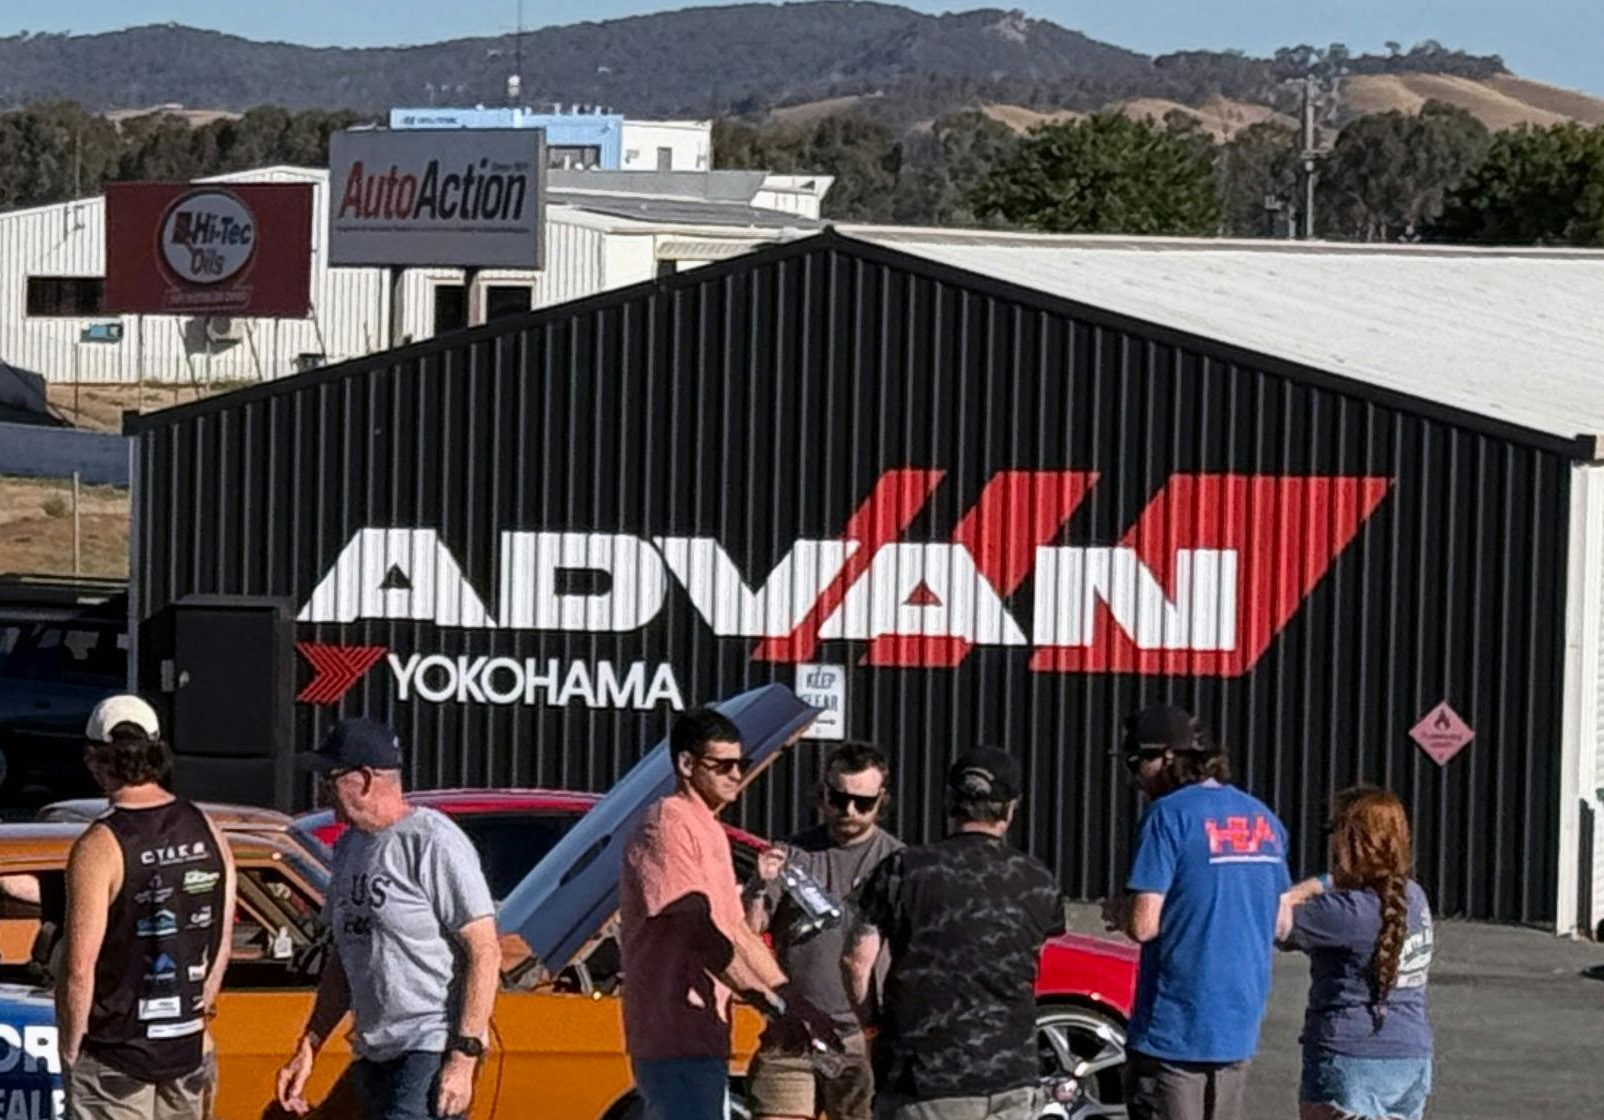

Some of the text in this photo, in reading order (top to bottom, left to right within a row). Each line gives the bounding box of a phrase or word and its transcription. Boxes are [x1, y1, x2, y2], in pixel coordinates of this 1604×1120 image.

[337, 157, 528, 221] AutoAction
[192, 211, 252, 245] Hi-Tec
[296, 527, 1237, 652] ADVAN
[388, 652, 685, 711] YOKOHAMA
